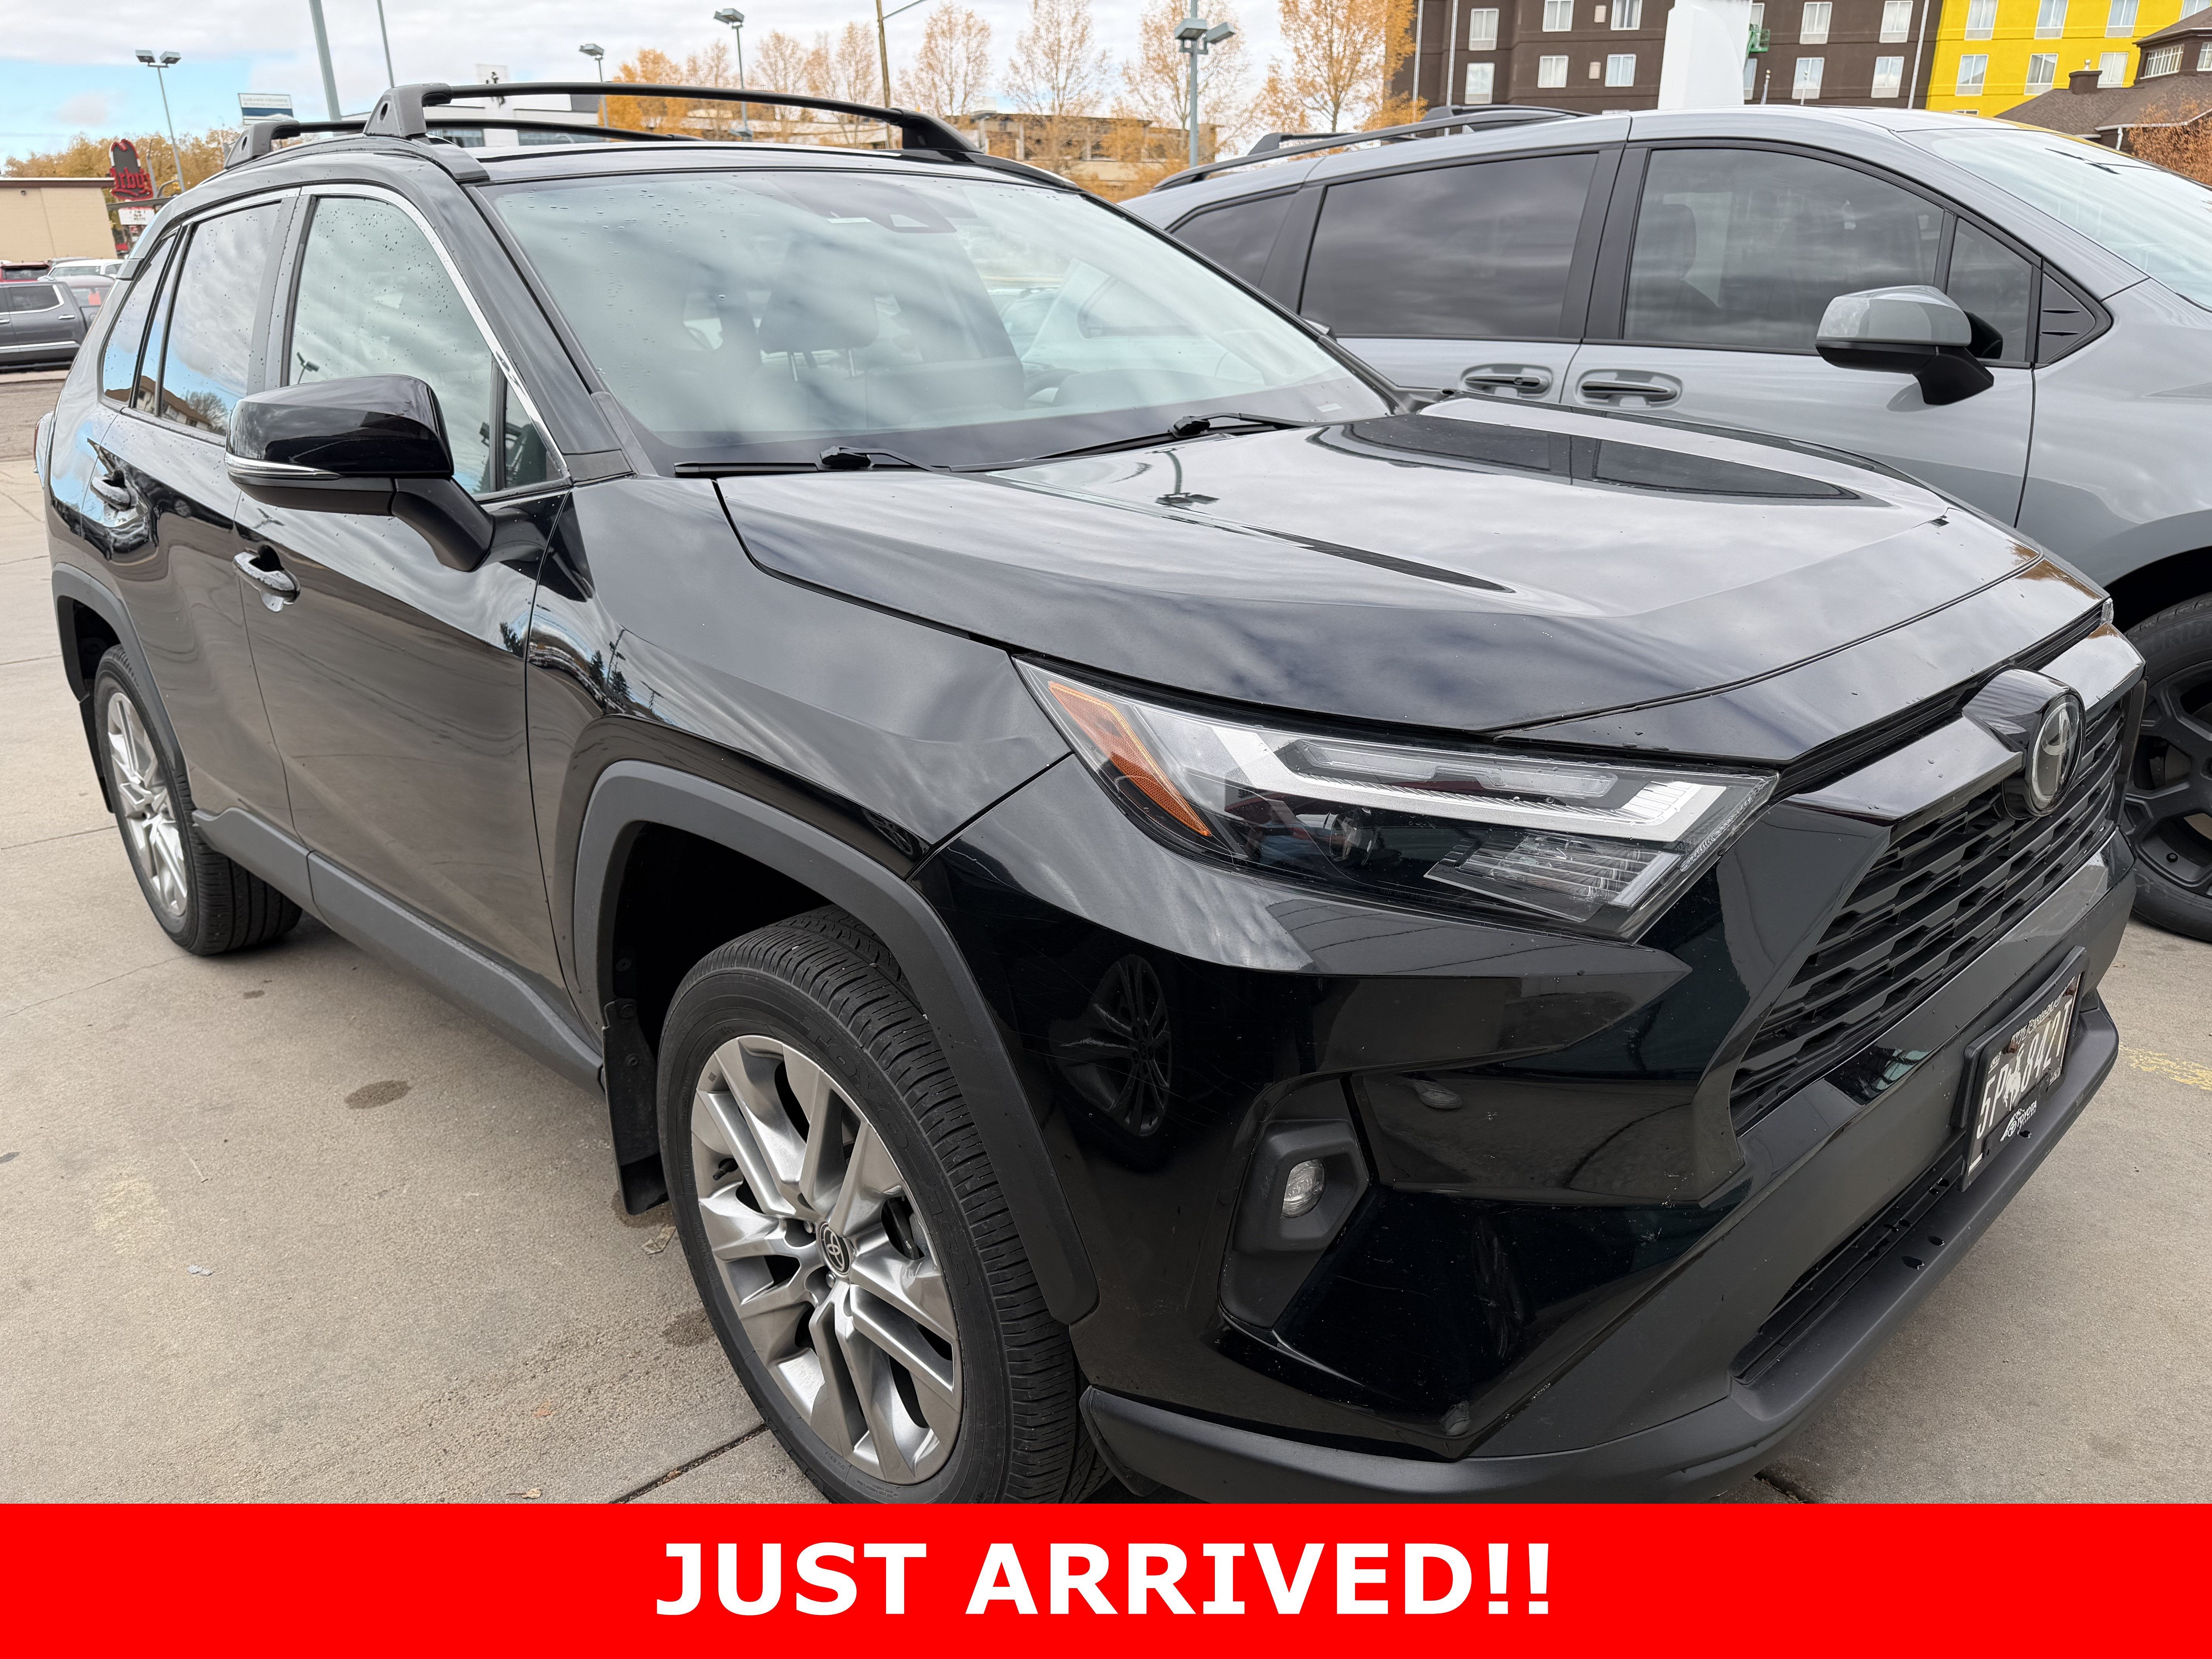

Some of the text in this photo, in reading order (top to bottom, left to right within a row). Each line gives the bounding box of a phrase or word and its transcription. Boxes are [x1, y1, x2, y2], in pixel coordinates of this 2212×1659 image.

[803, 1011, 910, 1154] TOYO
[2020, 997, 2073, 1092] 842T
[2017, 1100, 2037, 1127] TOYOTA
